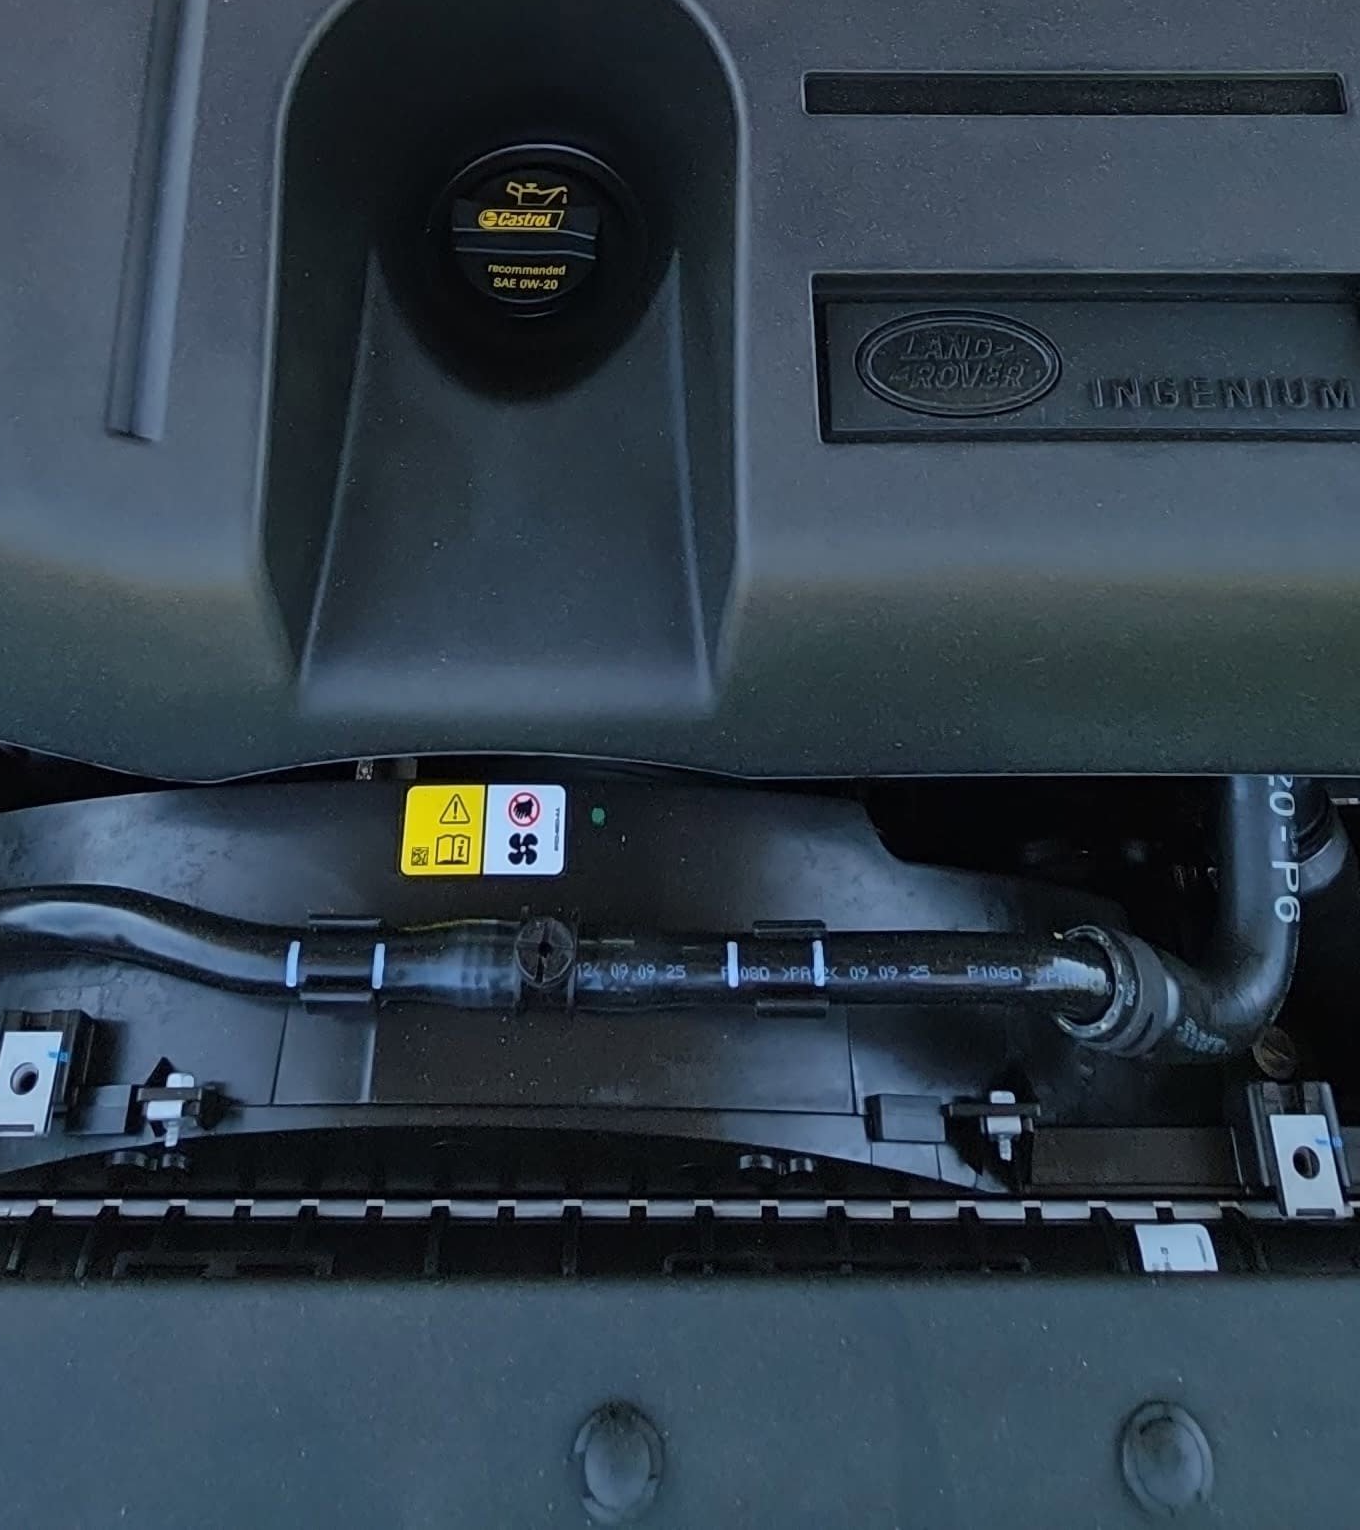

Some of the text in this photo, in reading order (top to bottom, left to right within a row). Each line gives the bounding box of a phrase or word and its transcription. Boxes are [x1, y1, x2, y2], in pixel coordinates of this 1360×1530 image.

[497, 212, 552, 227] Castrol
[488, 264, 566, 276] recommended
[493, 277, 558, 290] SAE 0W-20
[901, 333, 996, 361] LAND
[910, 364, 1026, 390] ROVER
[1087, 376, 1358, 411] INGENIUM
